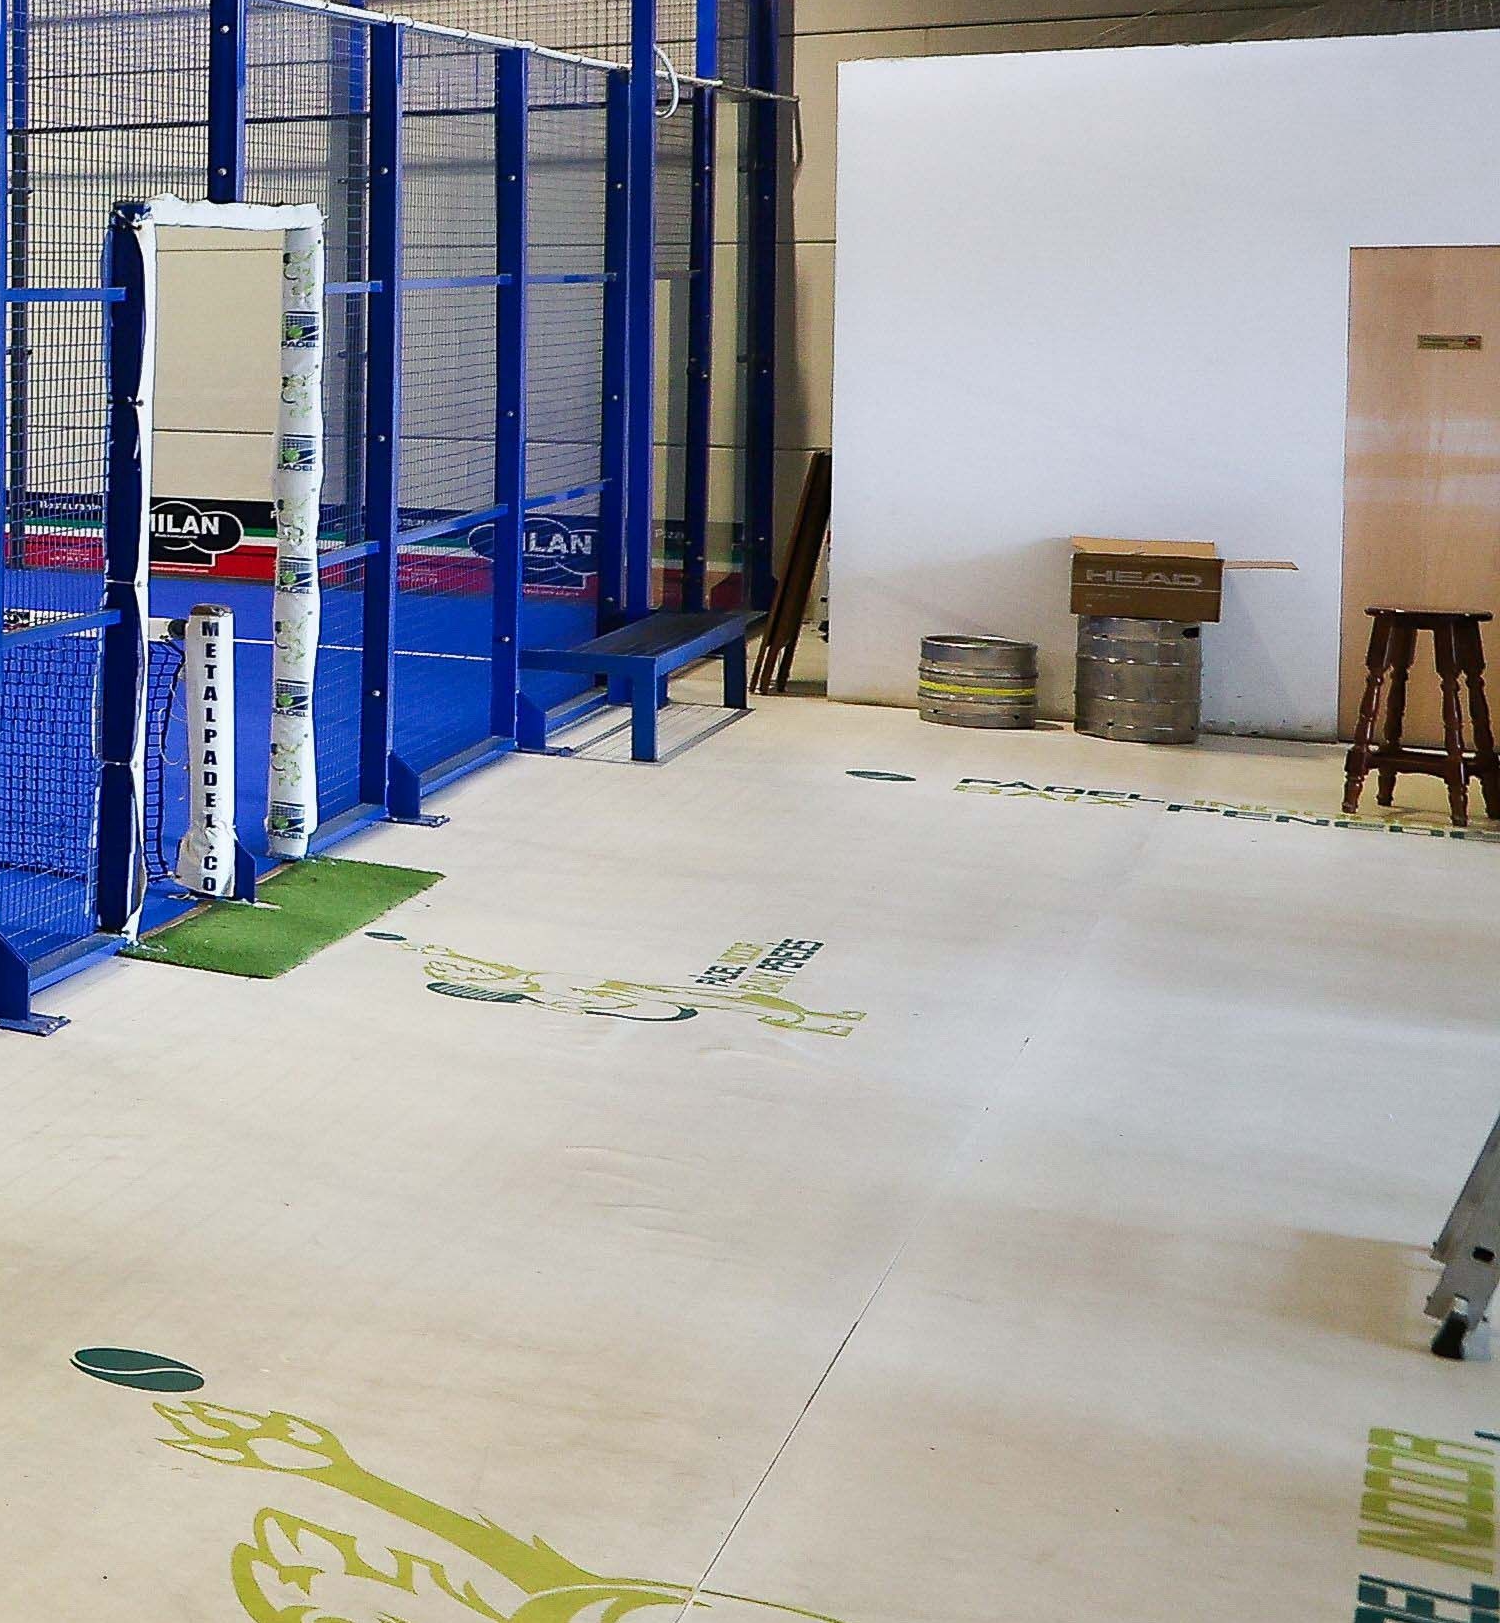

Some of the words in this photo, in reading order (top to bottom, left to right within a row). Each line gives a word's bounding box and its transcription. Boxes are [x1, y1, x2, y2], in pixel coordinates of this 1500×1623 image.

[280, 340, 319, 349] PADEL
[277, 463, 316, 472] PADEL
[1086, 569, 1203, 586] HEAD
